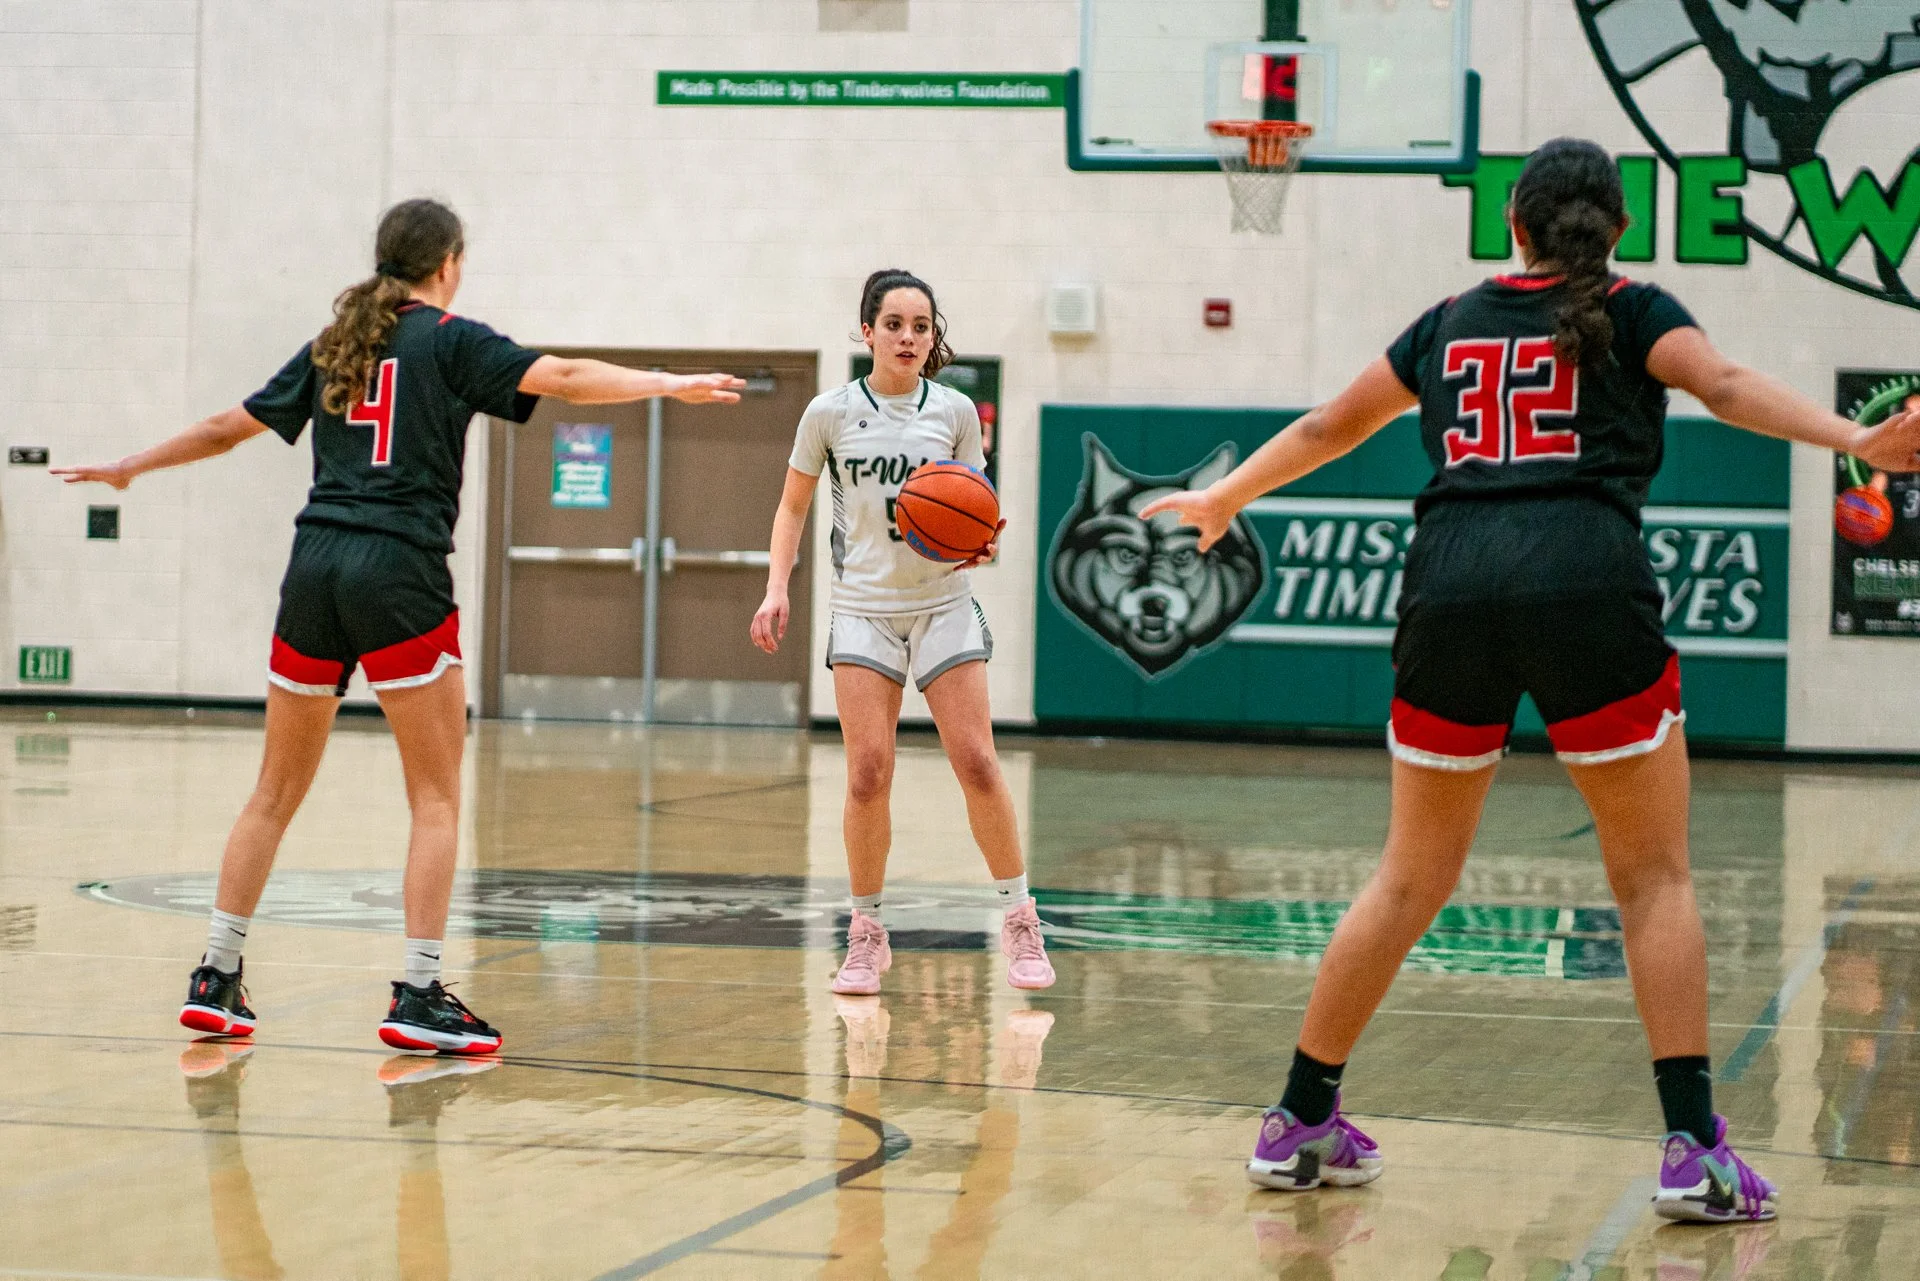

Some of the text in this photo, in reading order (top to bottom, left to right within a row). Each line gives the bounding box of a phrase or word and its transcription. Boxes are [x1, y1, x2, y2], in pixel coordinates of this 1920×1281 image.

[670, 79, 1049, 102] Made Possible by the Timberwolves Foundation
[345, 358, 399, 466] 4
[1442, 338, 1581, 469] 32
[1640, 528, 1759, 574] STA
